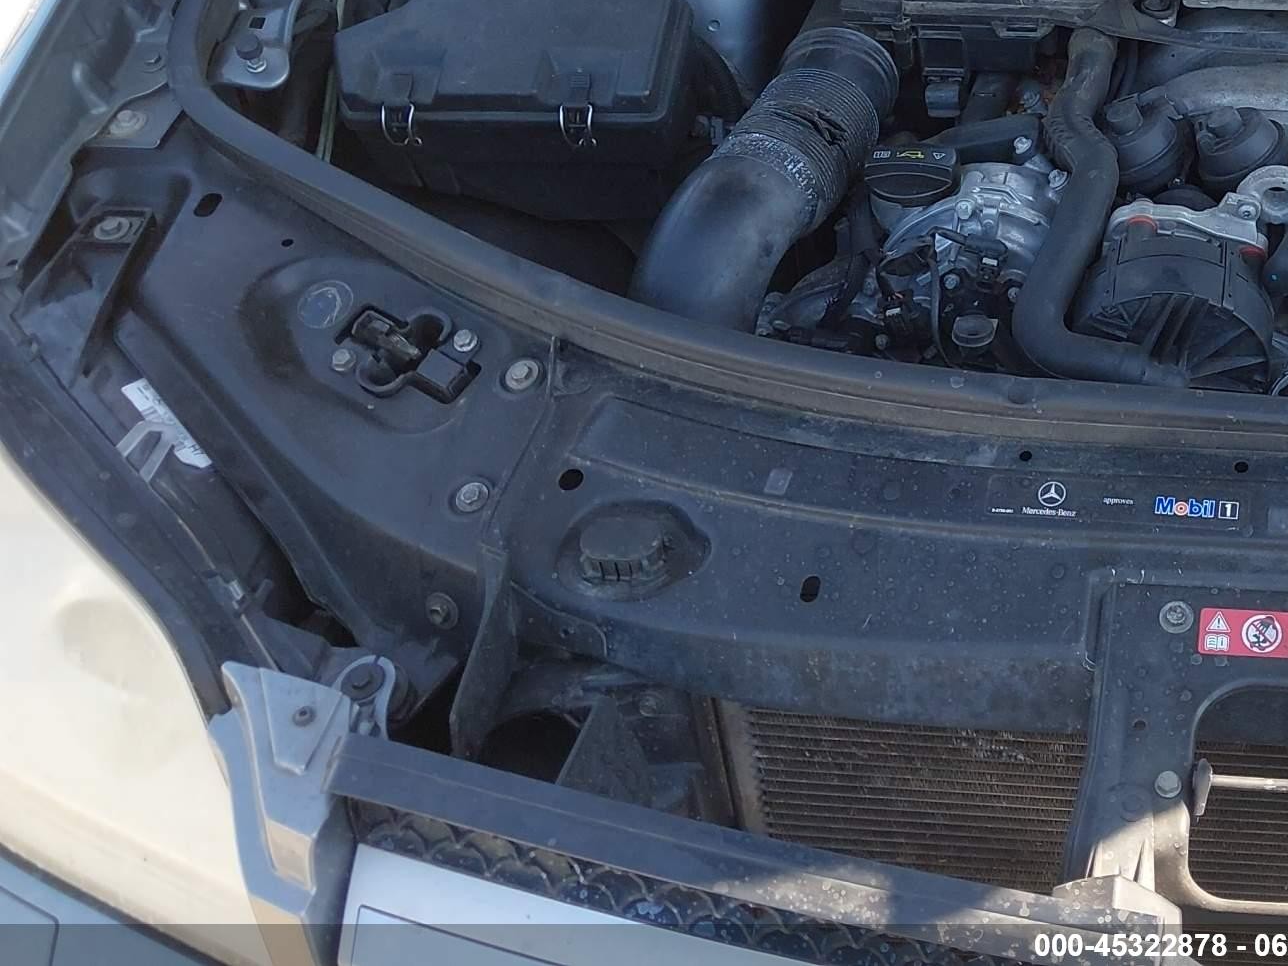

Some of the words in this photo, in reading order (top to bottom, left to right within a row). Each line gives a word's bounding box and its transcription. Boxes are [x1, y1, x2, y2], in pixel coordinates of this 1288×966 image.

[1103, 496, 1134, 506] approves
[1155, 496, 1216, 518] Mobil
[1021, 506, 1077, 518] Mercedes-Benz
